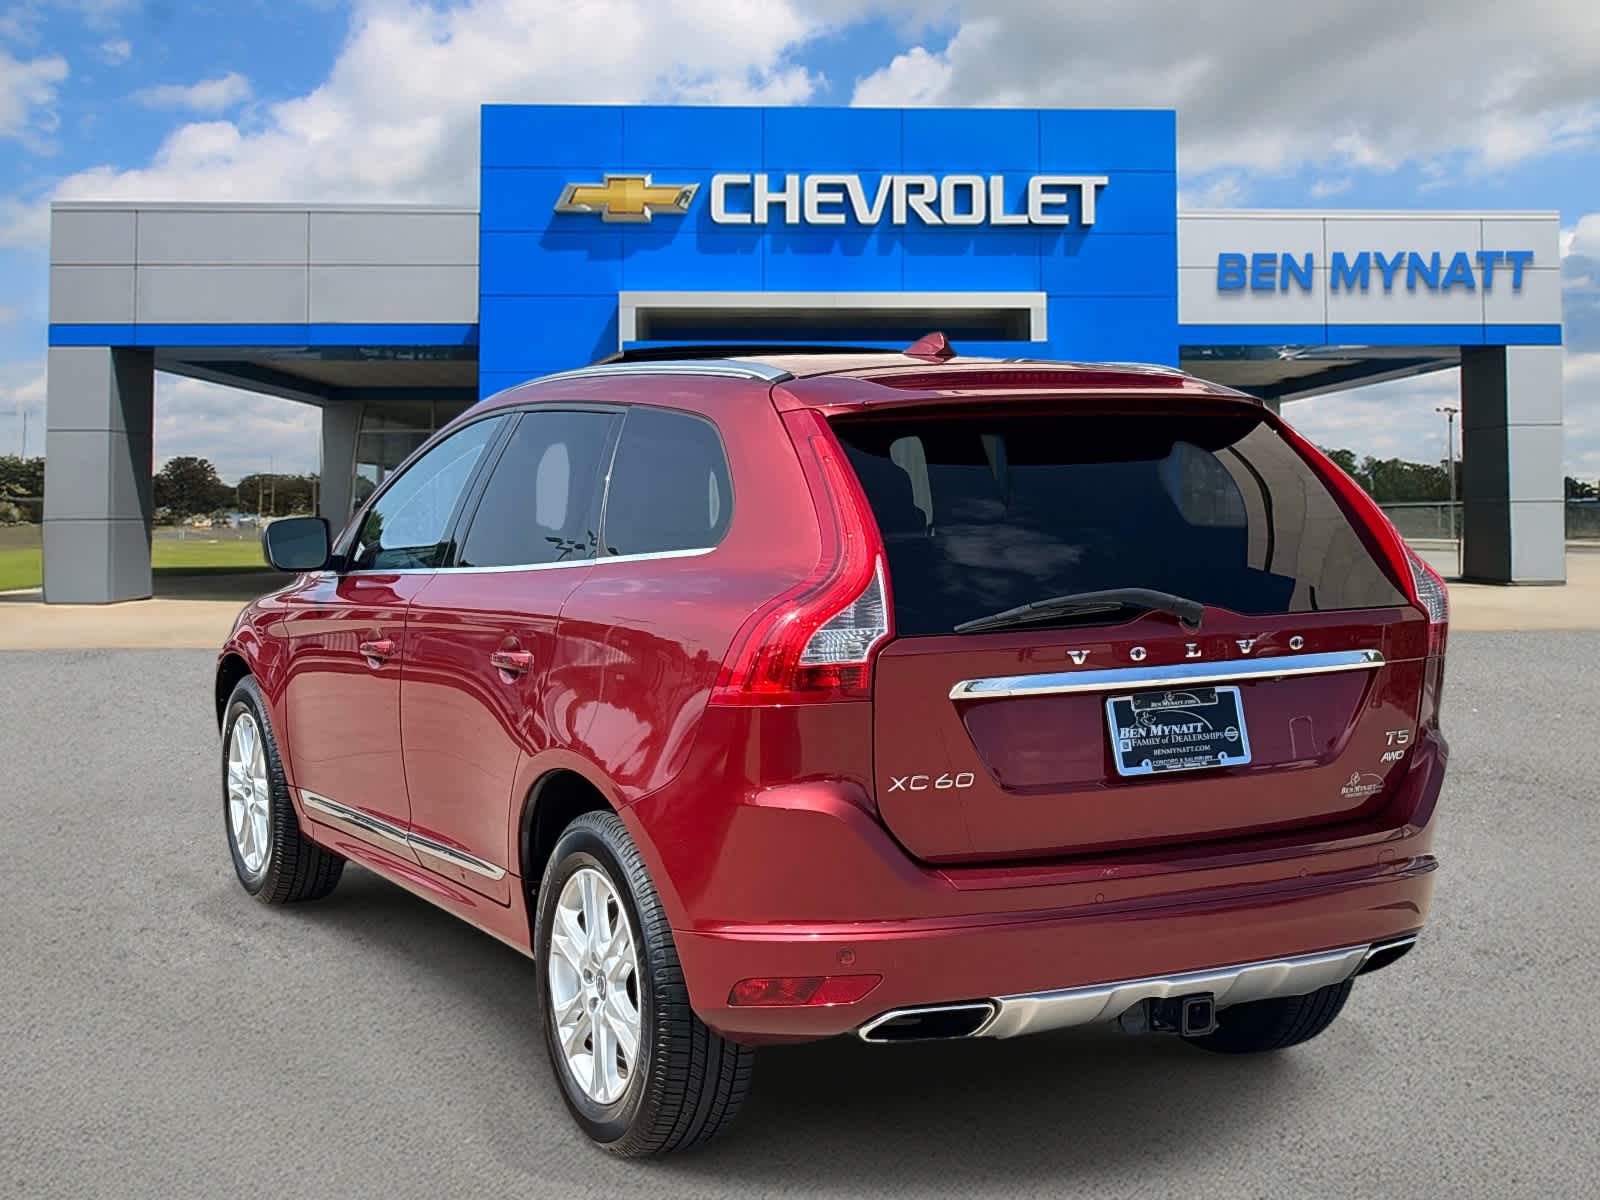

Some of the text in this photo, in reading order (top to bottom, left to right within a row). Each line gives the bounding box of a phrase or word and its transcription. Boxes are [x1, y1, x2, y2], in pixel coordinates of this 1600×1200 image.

[711, 174, 1109, 225] CHEVROLET
[1217, 250, 1534, 290] BEN MYNATT
[1066, 635, 1305, 665] VOLVO
[1120, 722, 1204, 739] BEN MYNATT
[1132, 731, 1225, 747] FAMILY of DEALERSHIPS
[1385, 729, 1409, 746] T5
[1153, 744, 1211, 756] BENMYNATT.COM
[1380, 750, 1405, 763] AWD
